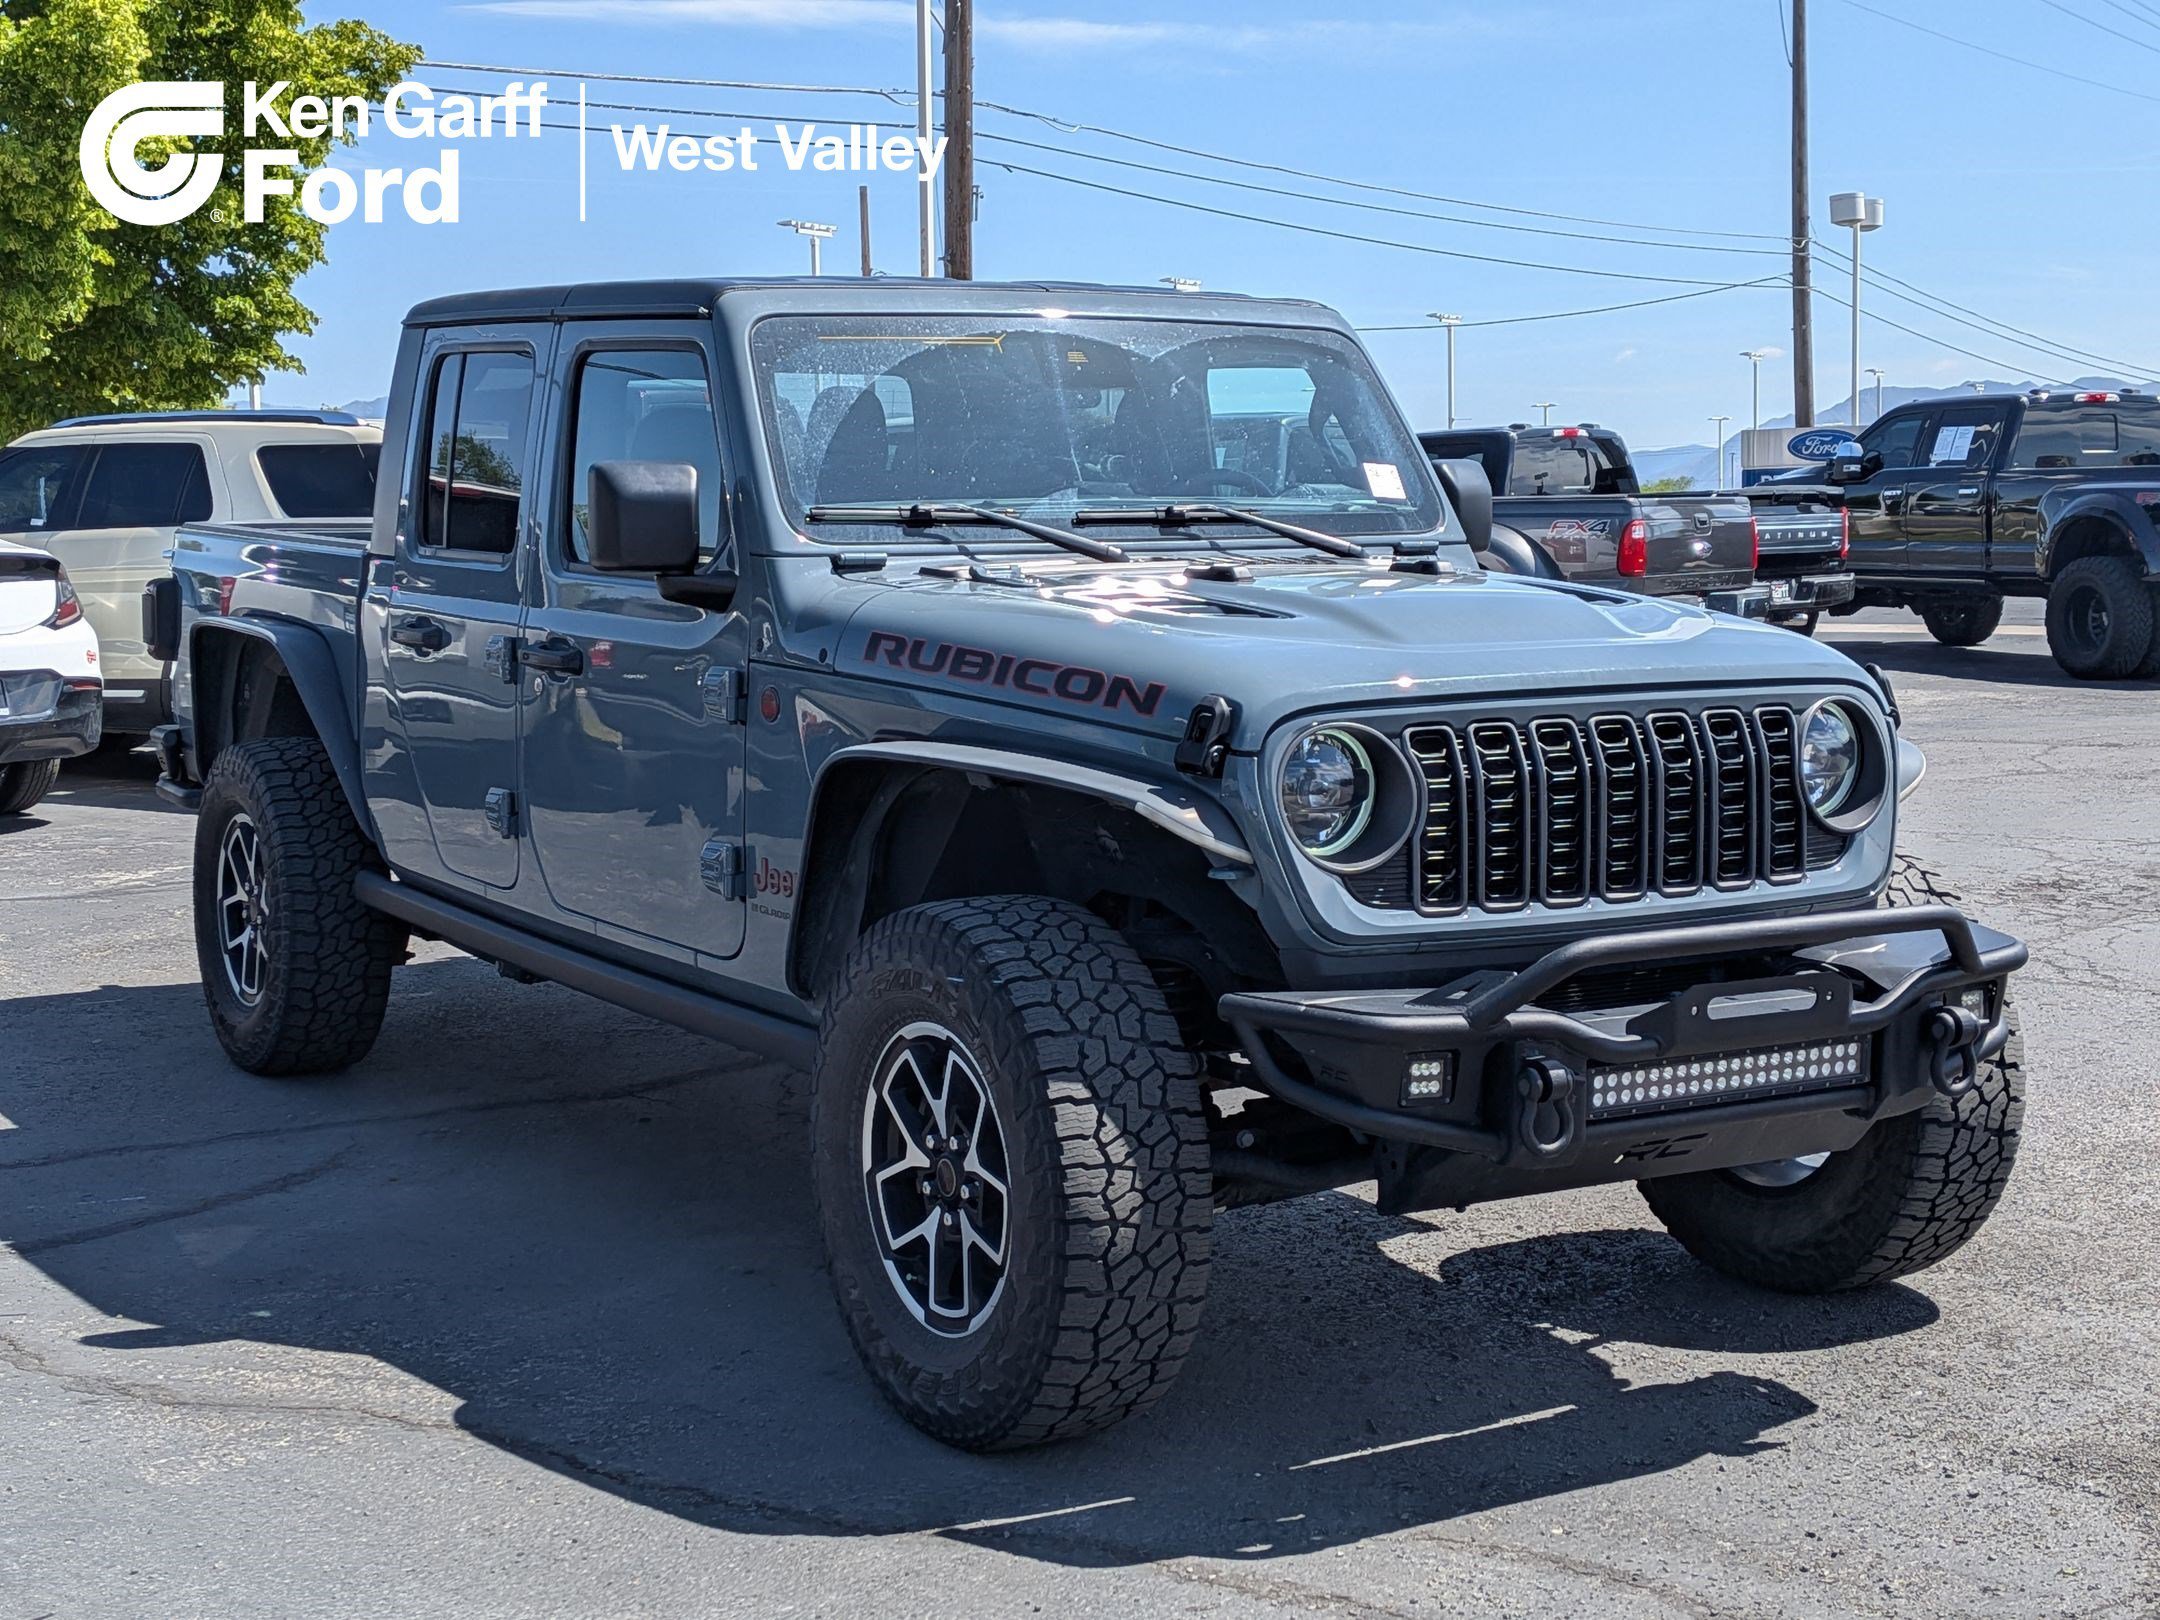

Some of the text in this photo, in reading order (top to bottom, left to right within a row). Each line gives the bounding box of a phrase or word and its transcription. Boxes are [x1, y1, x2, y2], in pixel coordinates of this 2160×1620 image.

[1548, 519, 1611, 536] FX4
[1763, 530, 1829, 541] ATINUM
[863, 630, 1167, 717] RUBICON
[753, 856, 796, 897] Jee
